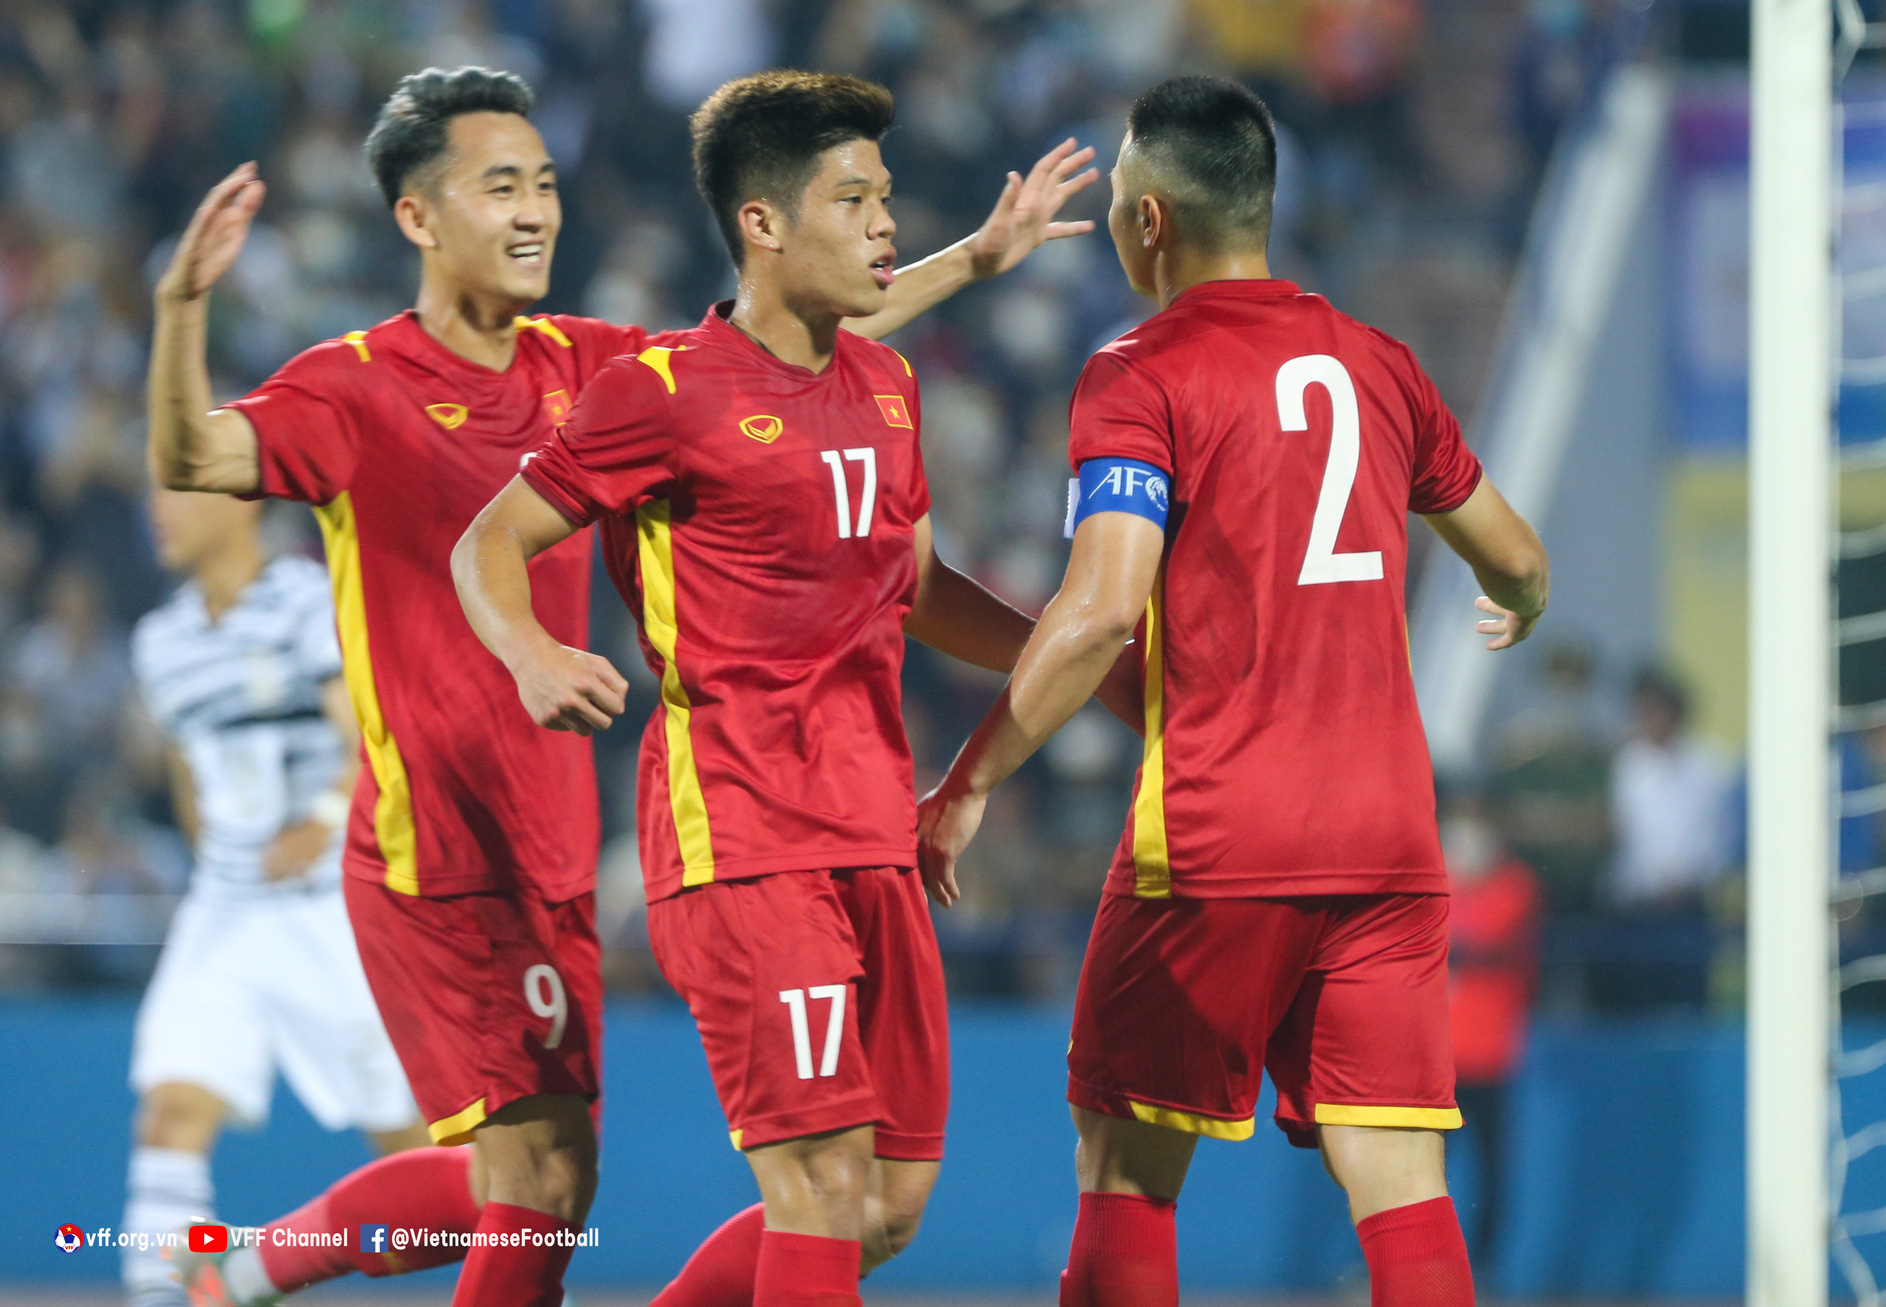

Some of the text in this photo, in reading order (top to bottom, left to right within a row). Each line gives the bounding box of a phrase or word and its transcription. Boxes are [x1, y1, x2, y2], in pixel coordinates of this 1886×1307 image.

[820, 447, 877, 539] 17
[1275, 354, 1384, 586] 2
[523, 963, 568, 1049] 9
[779, 984, 846, 1079] 17
